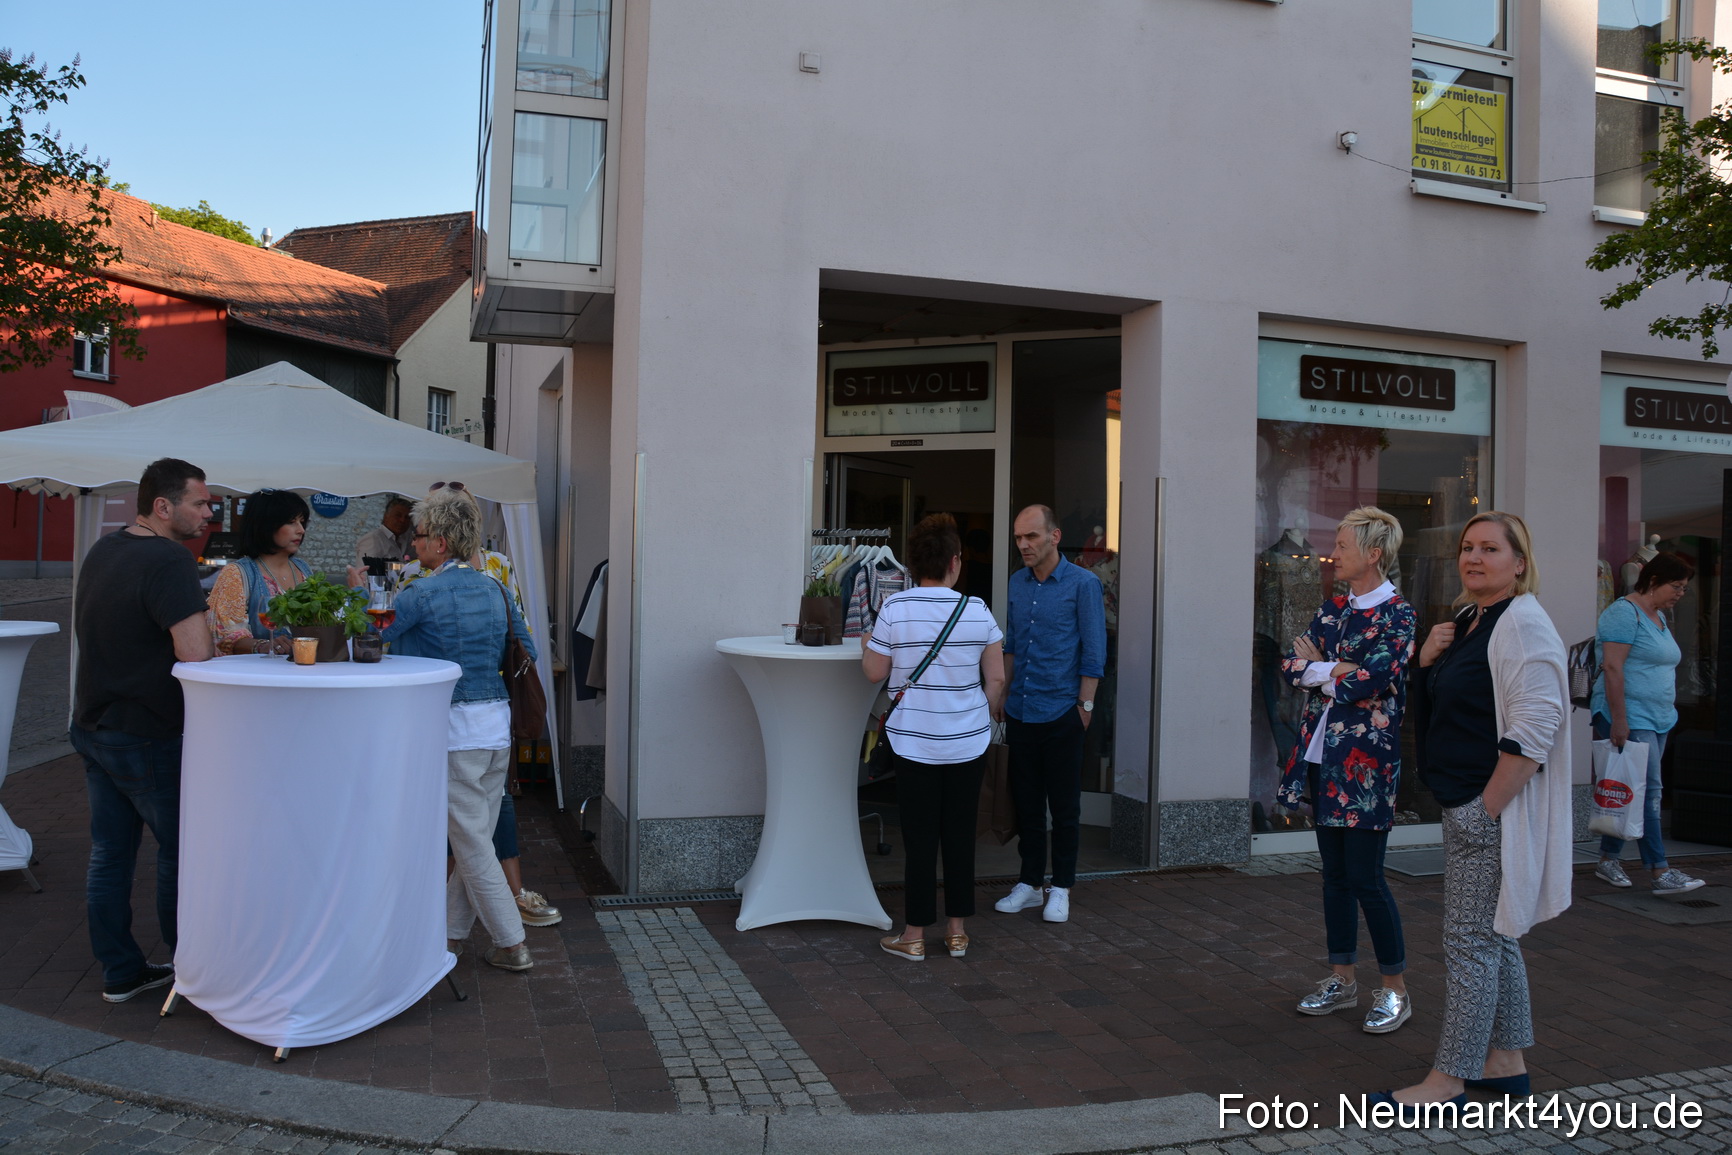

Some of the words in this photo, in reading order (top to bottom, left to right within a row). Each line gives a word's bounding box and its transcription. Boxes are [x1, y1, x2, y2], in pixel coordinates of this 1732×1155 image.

[1412, 80, 1427, 95] Zu
[1433, 88, 1497, 107] vermieten!
[1418, 118, 1495, 147] Lautenschlager
[1450, 141, 1470, 151] GmbH
[1421, 158, 1426, 168] 0
[843, 371, 979, 396] STILVOLL
[1311, 367, 1447, 400] STILVOLL
[842, 409, 876, 417] Mode
[905, 405, 979, 415] Lifestyle
[1310, 404, 1346, 415] Mode
[1359, 408, 1365, 416] &
[1377, 410, 1447, 423] Lifestyle
[1634, 397, 1732, 425] STILVOL
[1633, 431, 1663, 440] Mode
[1687, 435, 1732, 446] Lifesty
